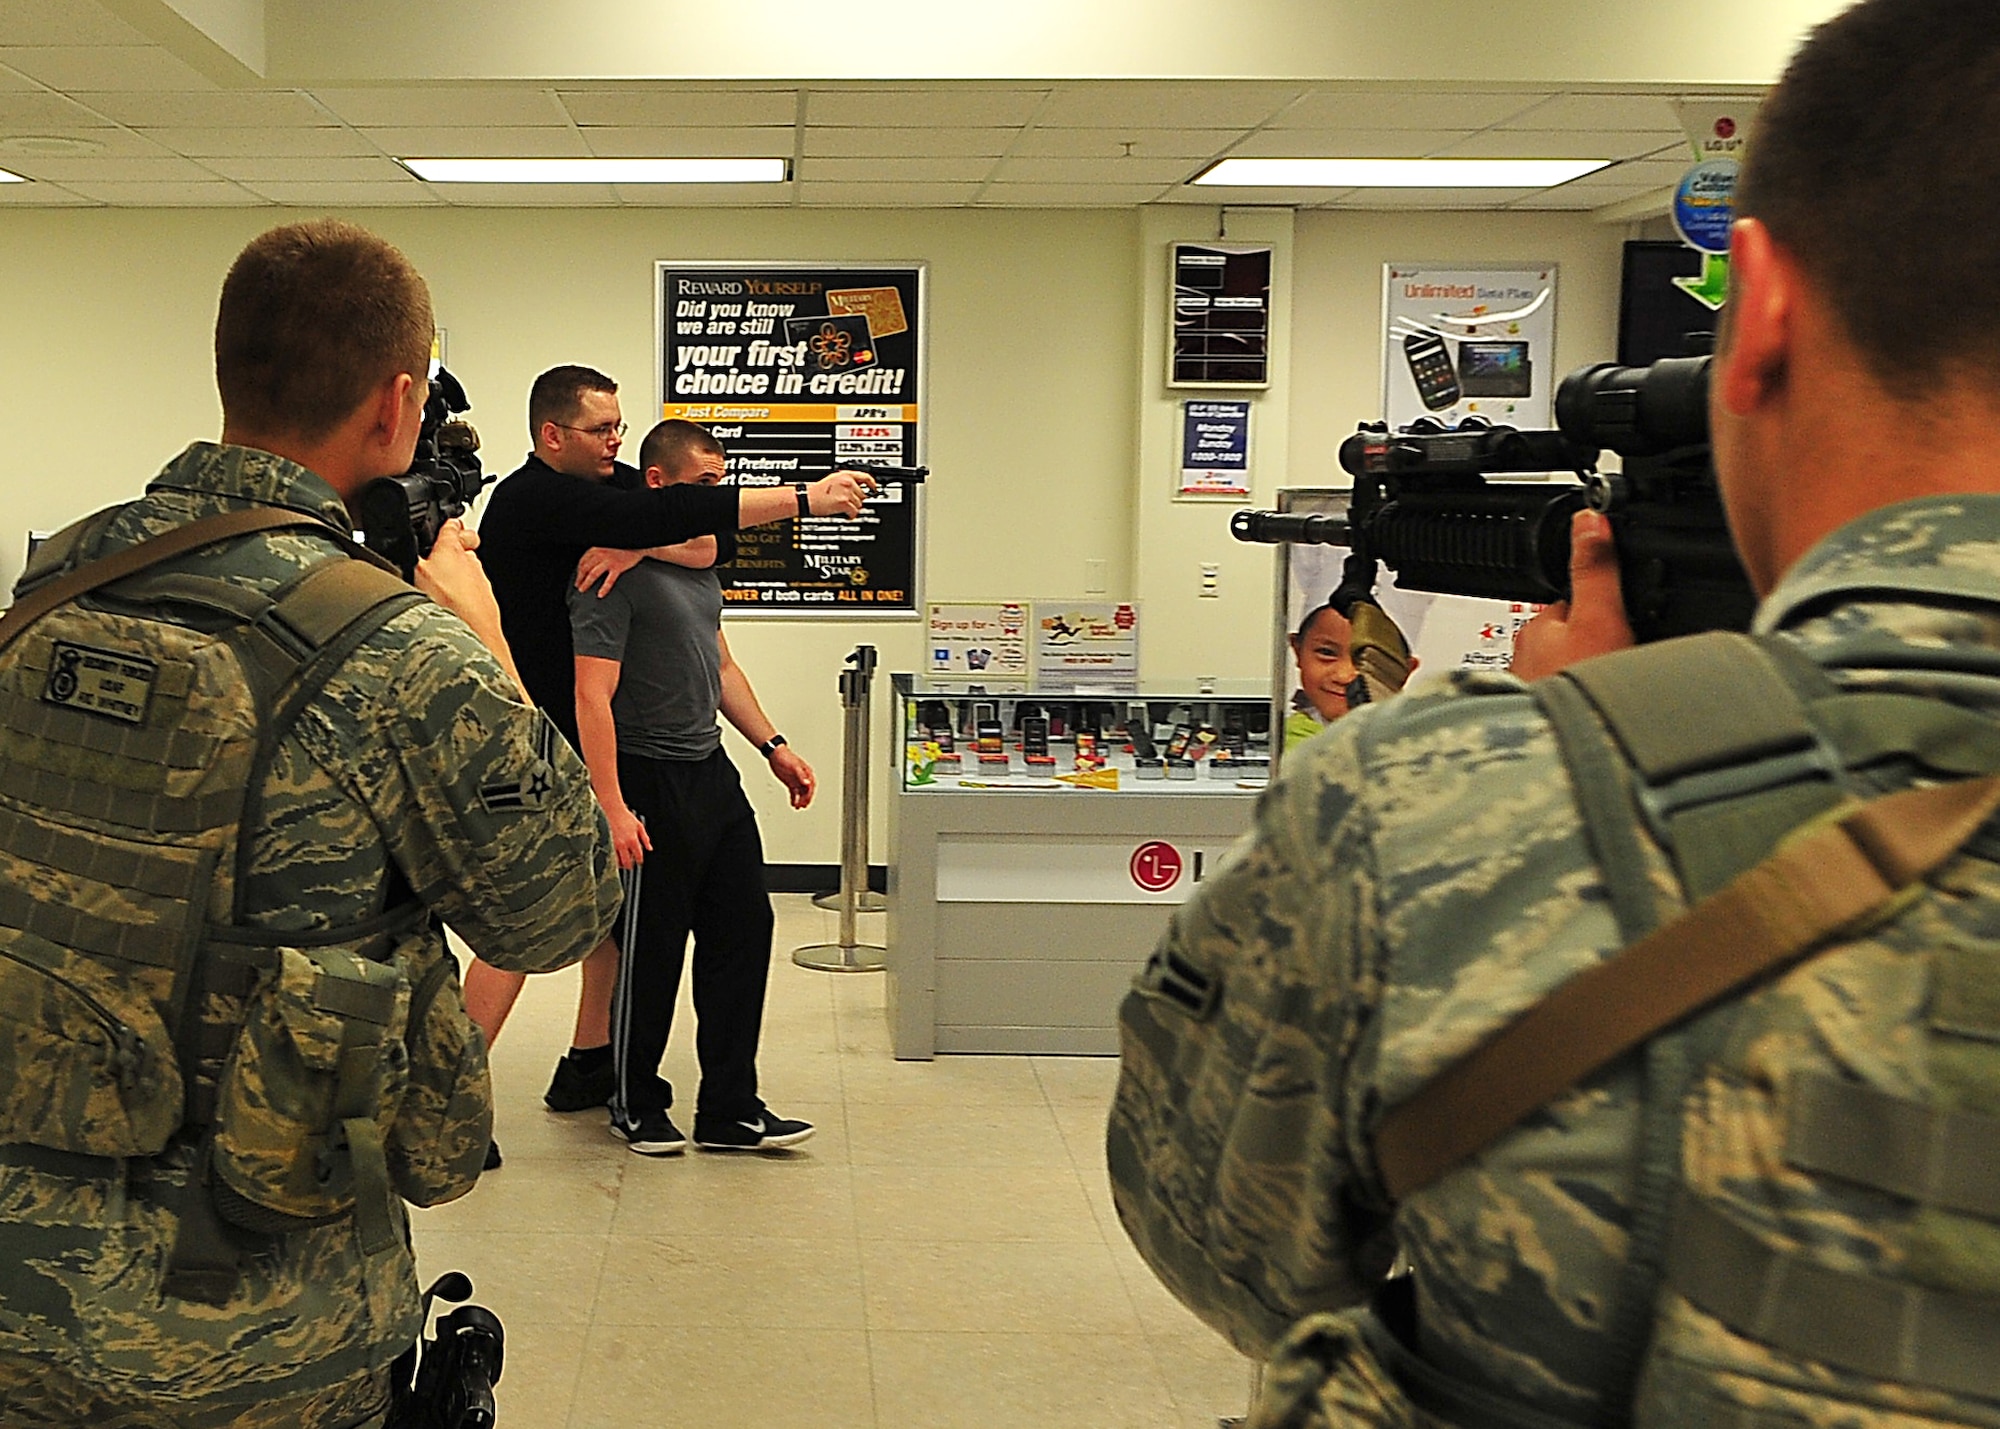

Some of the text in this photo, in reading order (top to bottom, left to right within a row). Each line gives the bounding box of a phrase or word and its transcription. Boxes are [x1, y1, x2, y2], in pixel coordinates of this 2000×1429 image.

[1404, 284, 1534, 300] Unlimited Data Plan
[676, 301, 796, 320] Did you know
[676, 321, 704, 335] we
[706, 321, 737, 335] are
[740, 318, 775, 335] still
[674, 340, 808, 372] your first
[674, 368, 905, 395] choice in credit!
[681, 405, 770, 420] Just Compare
[711, 425, 743, 438] Card
[738, 457, 799, 470] Preferred
[738, 473, 781, 486] Choice
[804, 554, 862, 569] MILITARY
[820, 565, 852, 580] STAR
[761, 589, 775, 601] of
[775, 589, 801, 601] both
[802, 589, 836, 601] cards
[837, 590, 858, 601] ALL
[861, 590, 874, 601] IN
[931, 619, 987, 631] Sign up for
